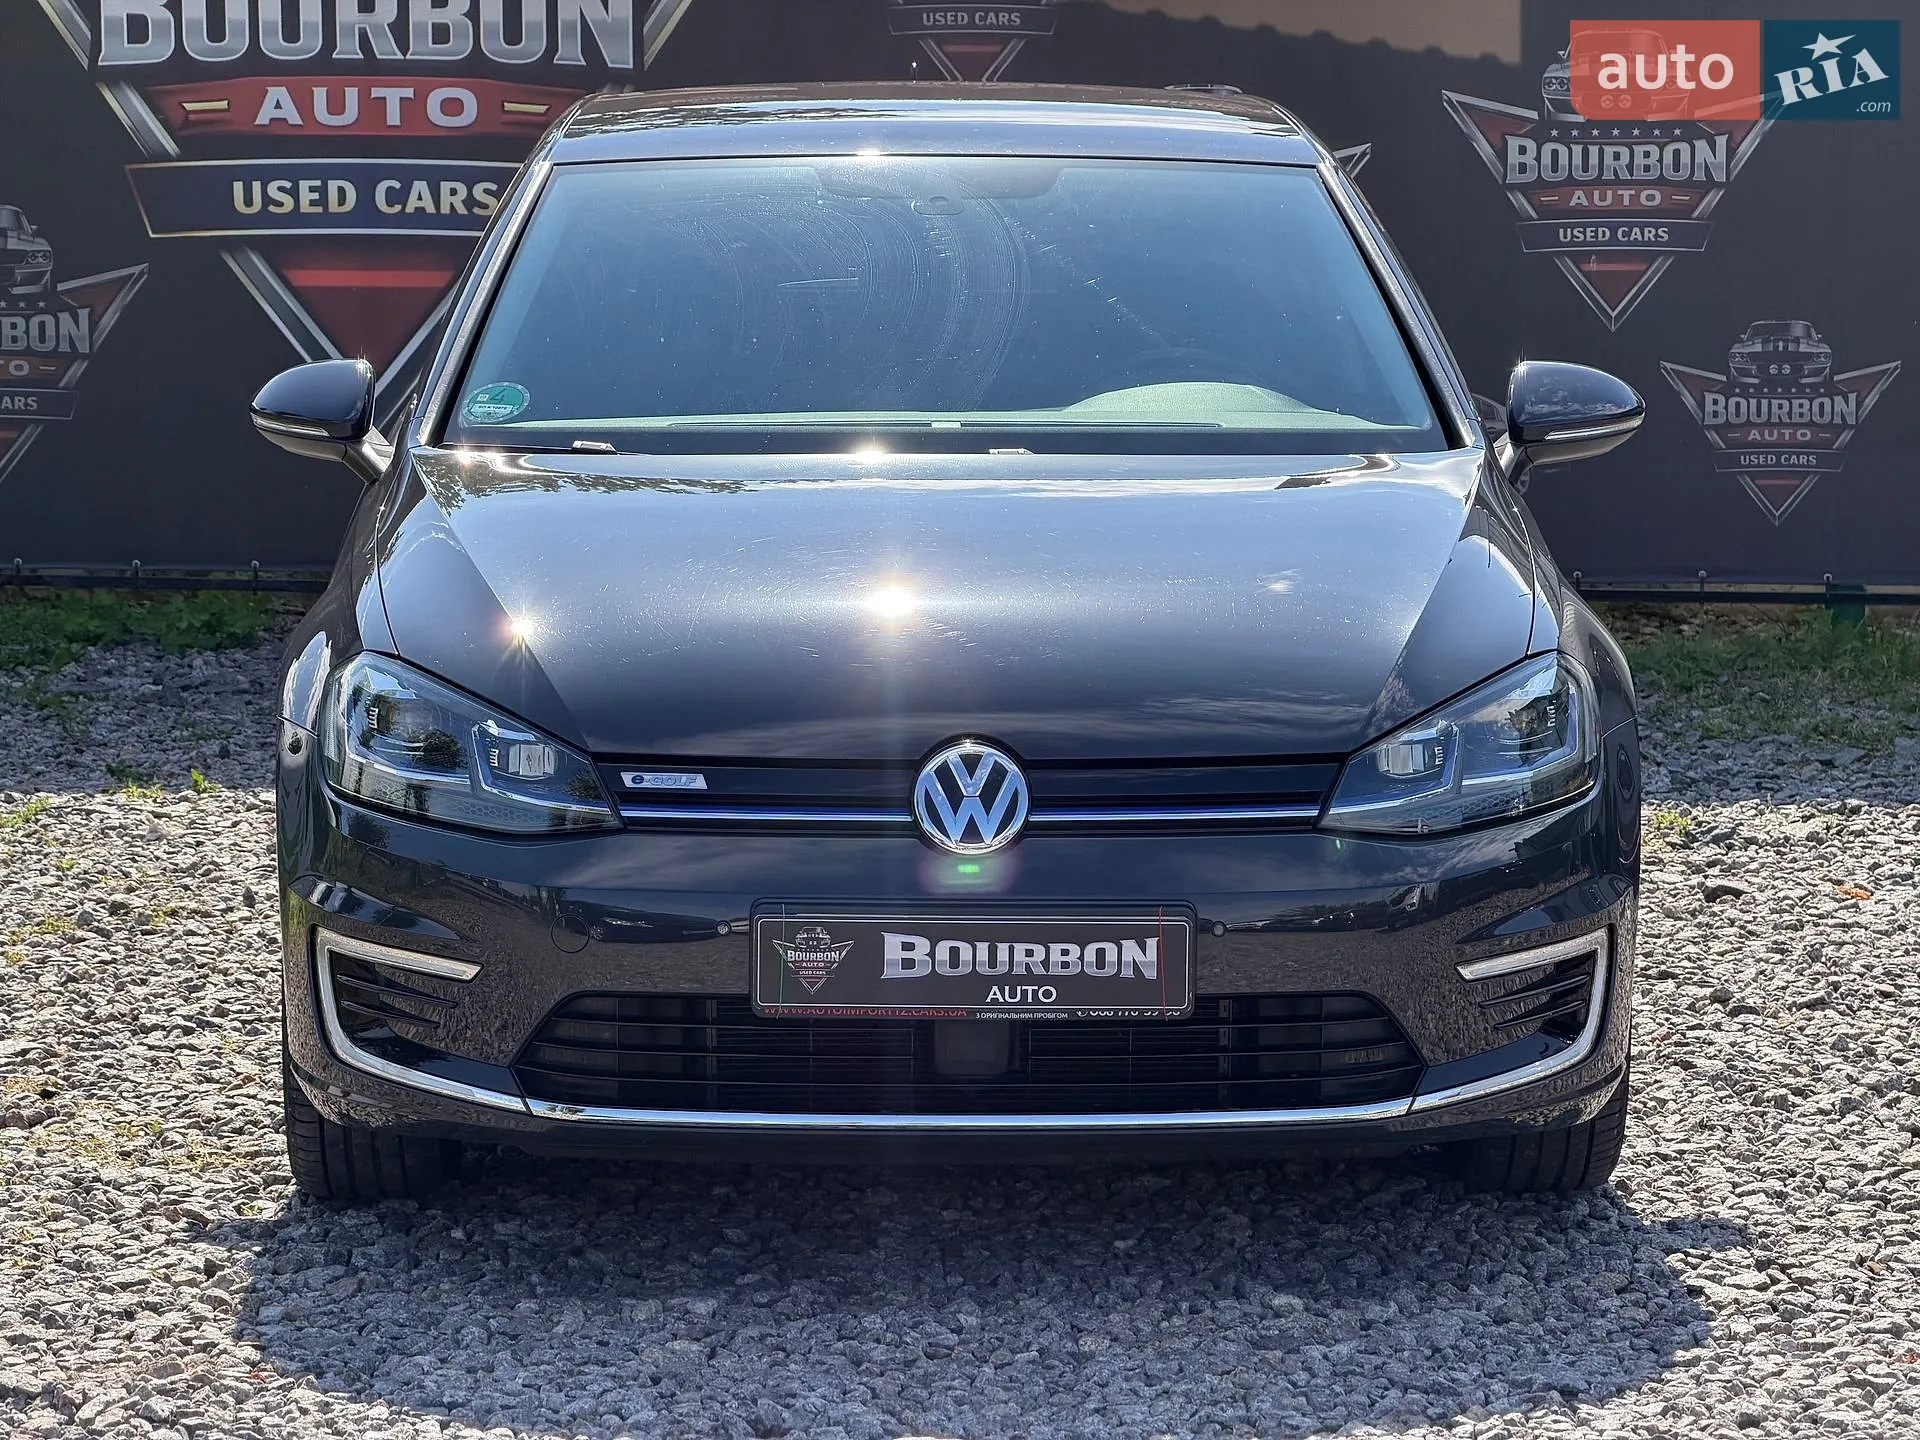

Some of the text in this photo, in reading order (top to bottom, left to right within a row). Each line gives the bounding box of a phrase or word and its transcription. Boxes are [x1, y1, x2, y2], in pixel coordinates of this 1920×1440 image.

[922, 12, 1021, 25] USED CARS
[98, 0, 635, 69] BOURBON
[254, 86, 480, 129] AUTO
[1504, 134, 1729, 184] BOURBON
[232, 180, 499, 217] USED CARS
[1568, 189, 1662, 207] AUTO
[1558, 227, 1669, 242] USED CARS
[0, 396, 38, 410] ARS
[1703, 391, 1859, 425] BOURBON
[1748, 429, 1812, 441] AUTO
[1740, 455, 1817, 465] USED CARS
[787, 950, 840, 962] BOURBON
[880, 931, 1160, 980] BOURBON
[985, 985, 1058, 1003] AUTO
